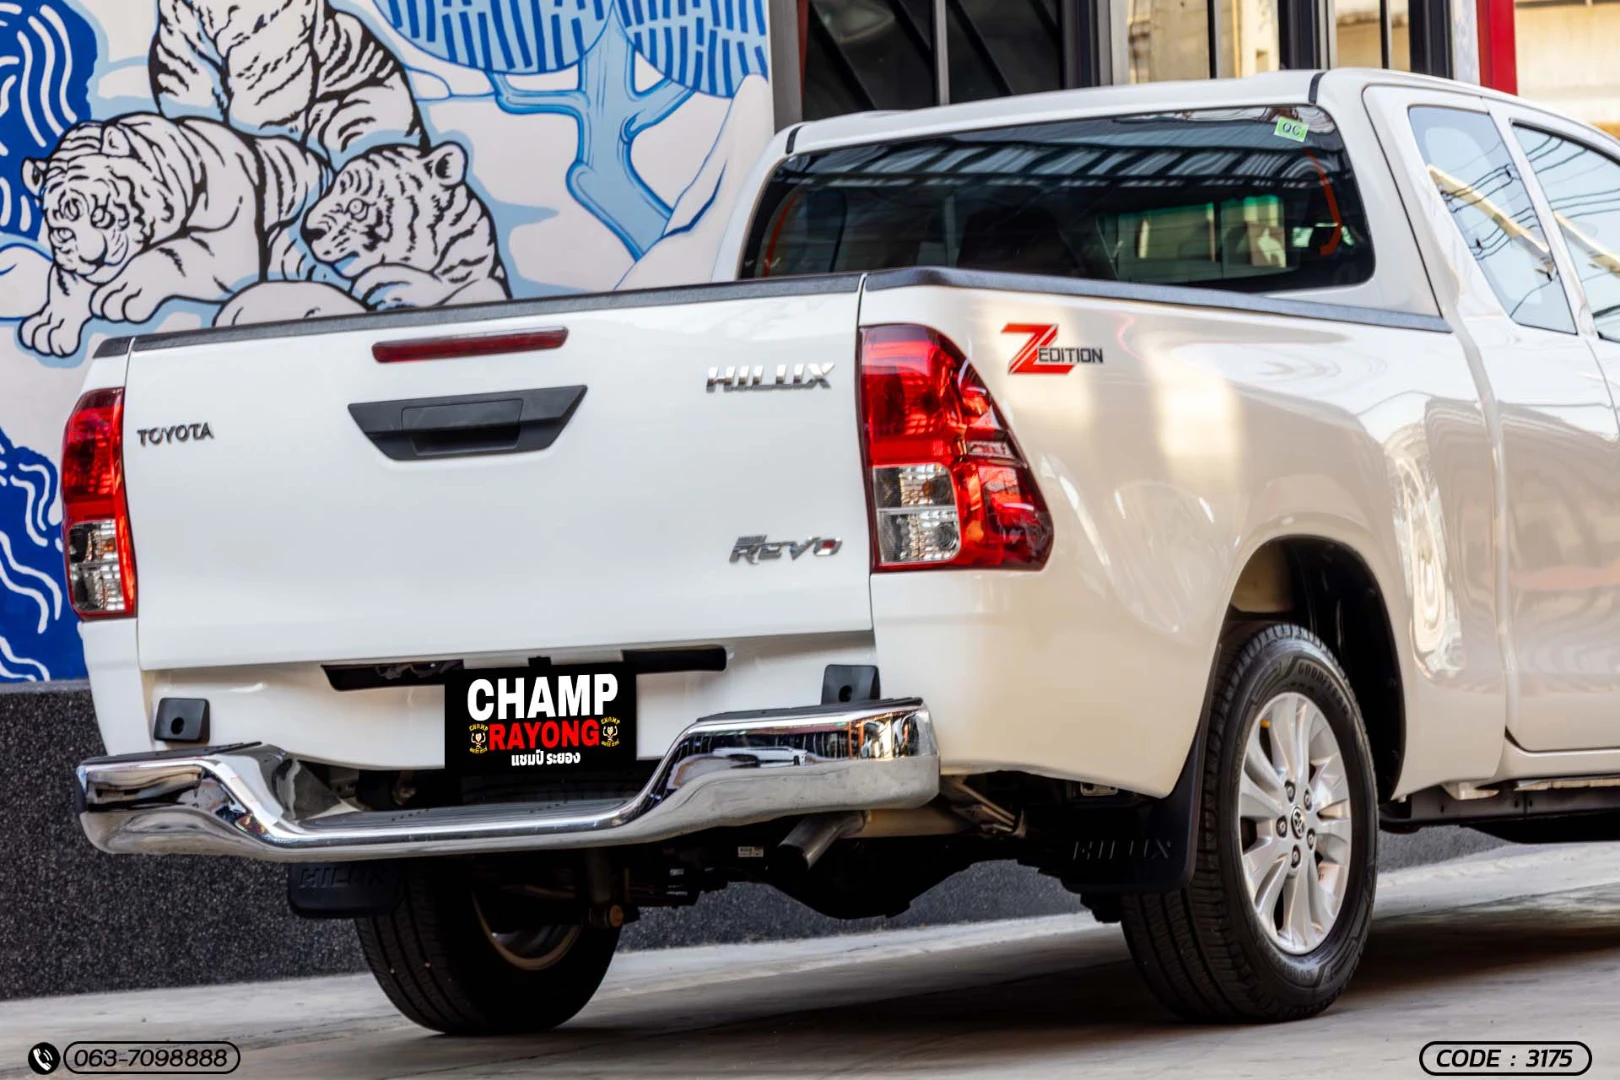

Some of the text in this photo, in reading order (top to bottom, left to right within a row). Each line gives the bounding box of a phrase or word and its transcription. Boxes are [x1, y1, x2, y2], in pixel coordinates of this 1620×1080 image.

[1282, 122, 1301, 136] QC
[1001, 323, 1076, 375] Z
[706, 361, 835, 393] HILUX
[137, 422, 214, 447] TOYOTA
[467, 673, 618, 722] CHAMP
[489, 719, 600, 751] RAYONG
[546, 752, 581, 765] ระยอง
